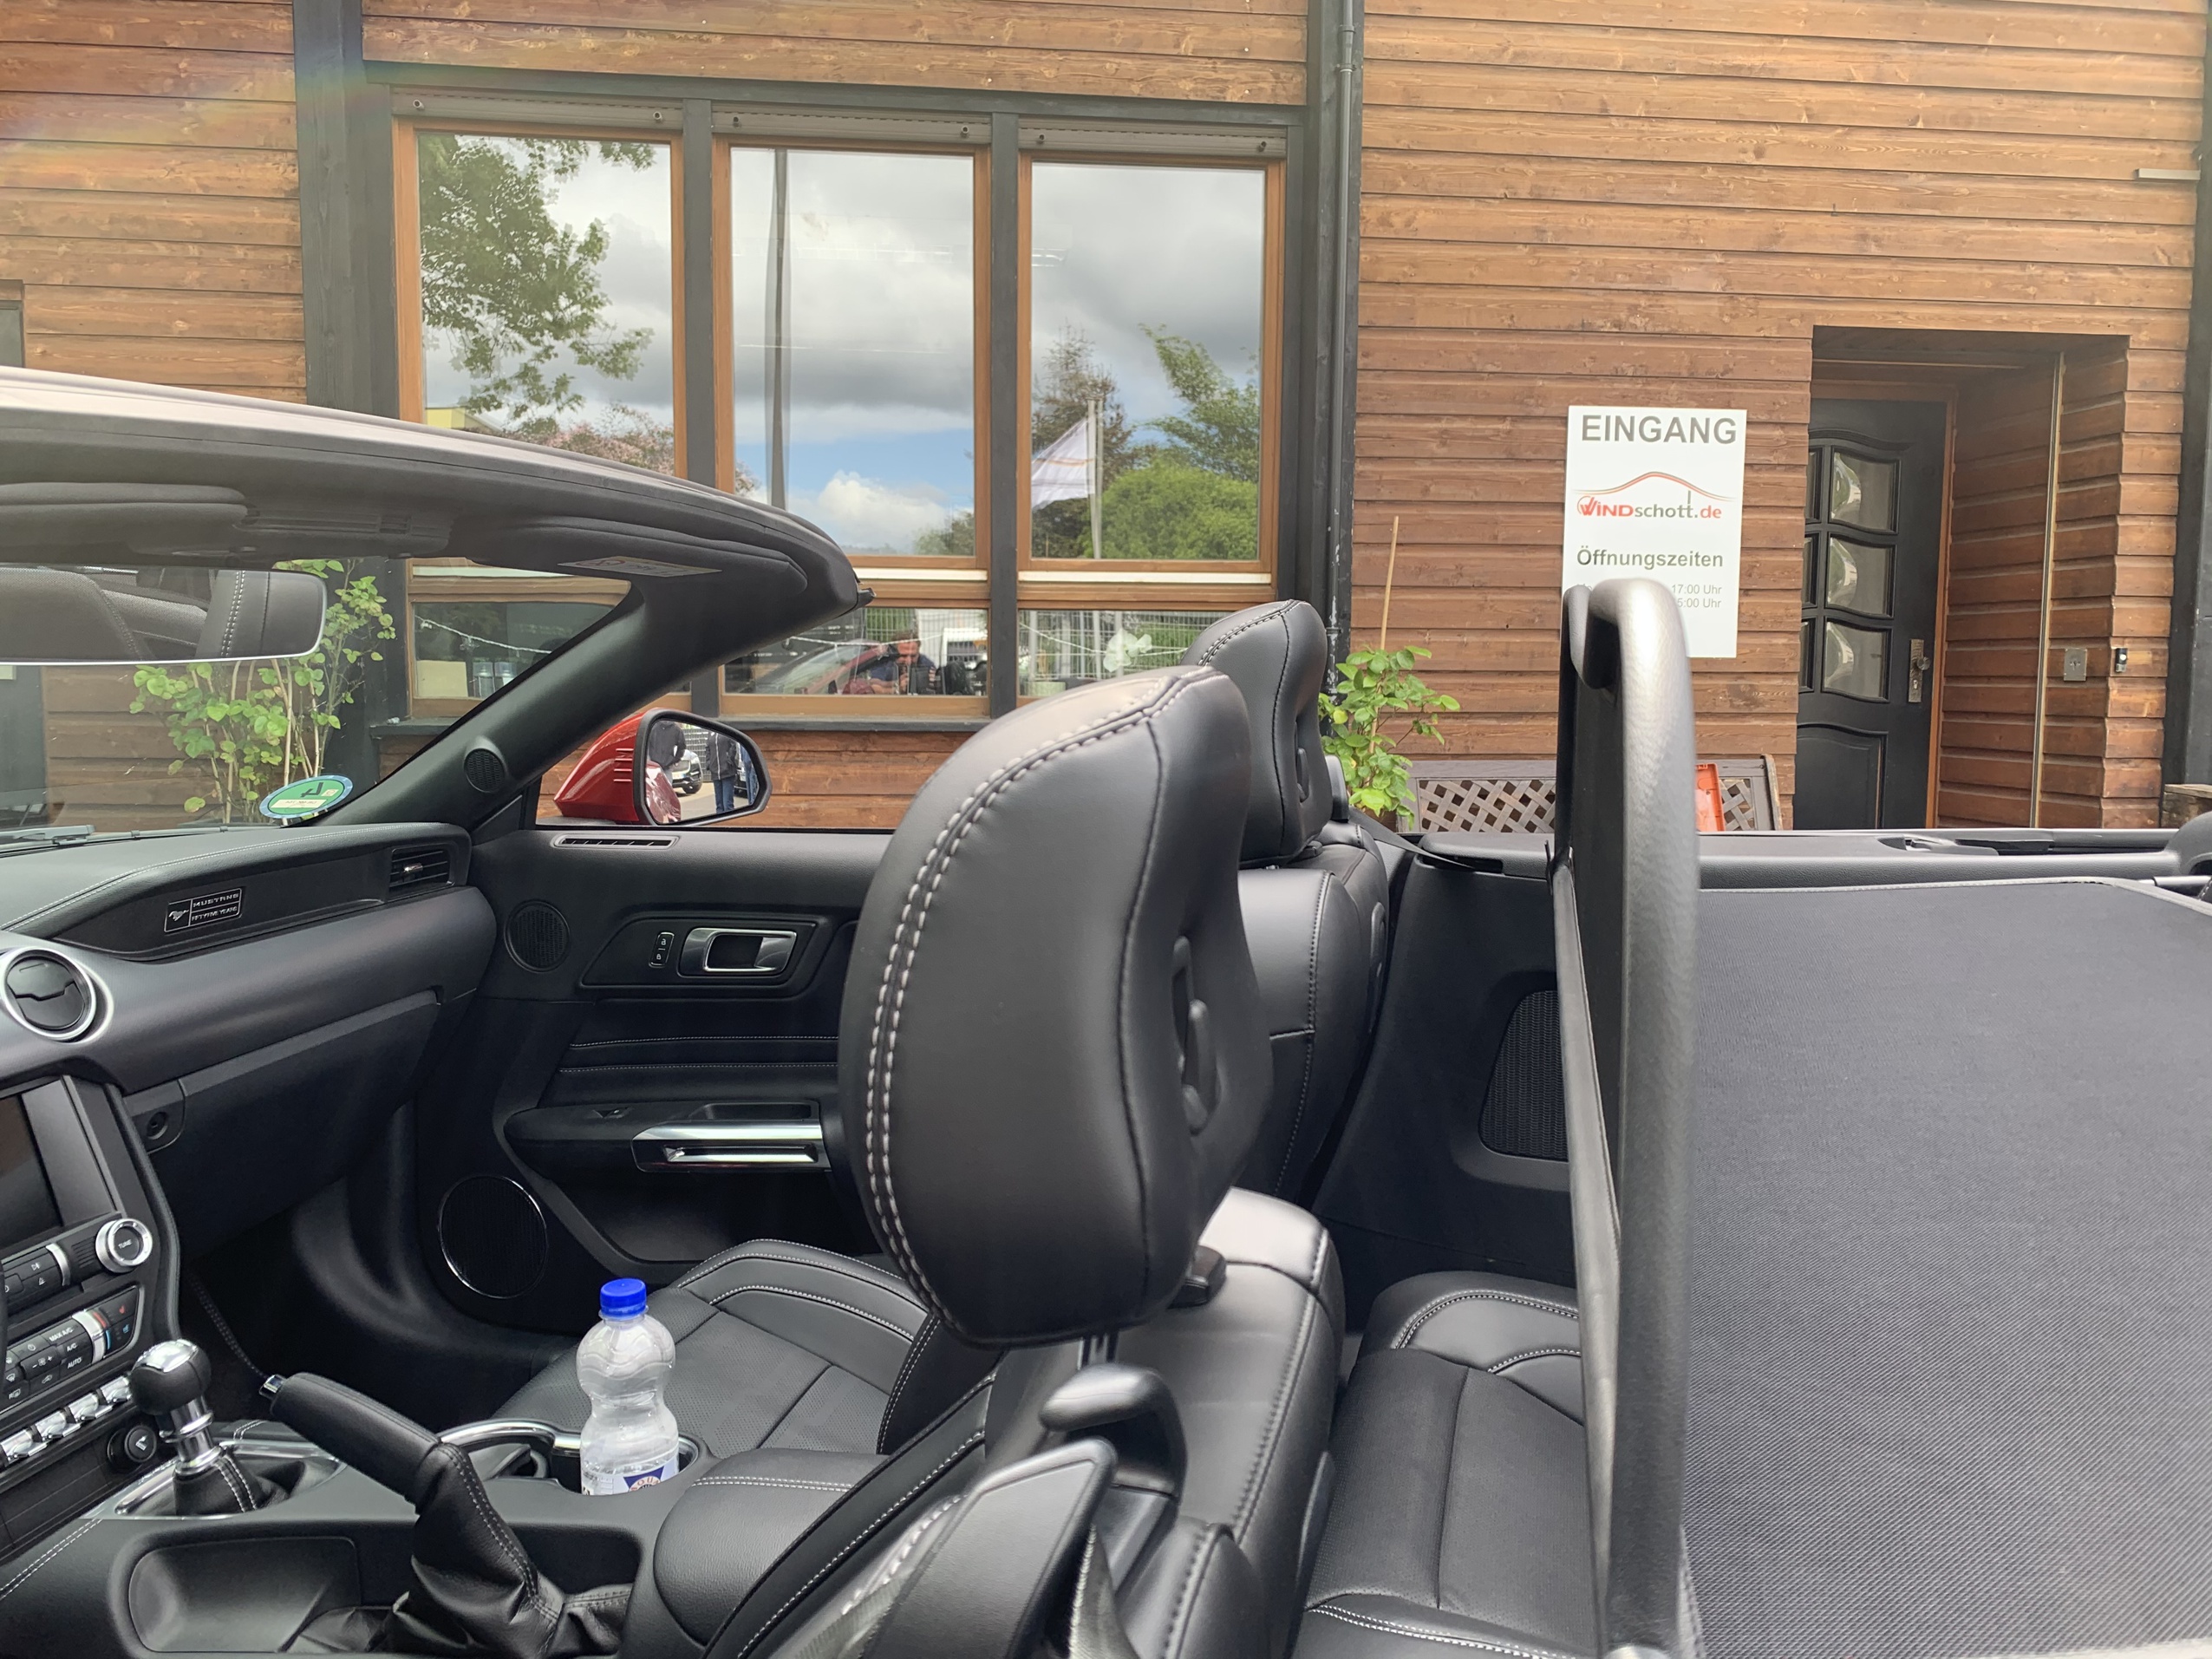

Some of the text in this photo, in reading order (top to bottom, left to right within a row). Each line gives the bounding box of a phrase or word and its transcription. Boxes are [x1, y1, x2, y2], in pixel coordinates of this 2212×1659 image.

[1582, 415, 1737, 445] EINGANG
[1576, 545, 1724, 571] Öffnungszeiten
[1671, 584, 1722, 595] 17:00 Uhr
[1676, 598, 1722, 608] 5:00 Uhr
[192, 893, 238, 907] MUSTANG
[118, 1239, 133, 1249] TUNE
[49, 1327, 75, 1342] MAX A/C
[66, 1342, 78, 1352] A/C
[67, 1356, 82, 1369] AUTO
